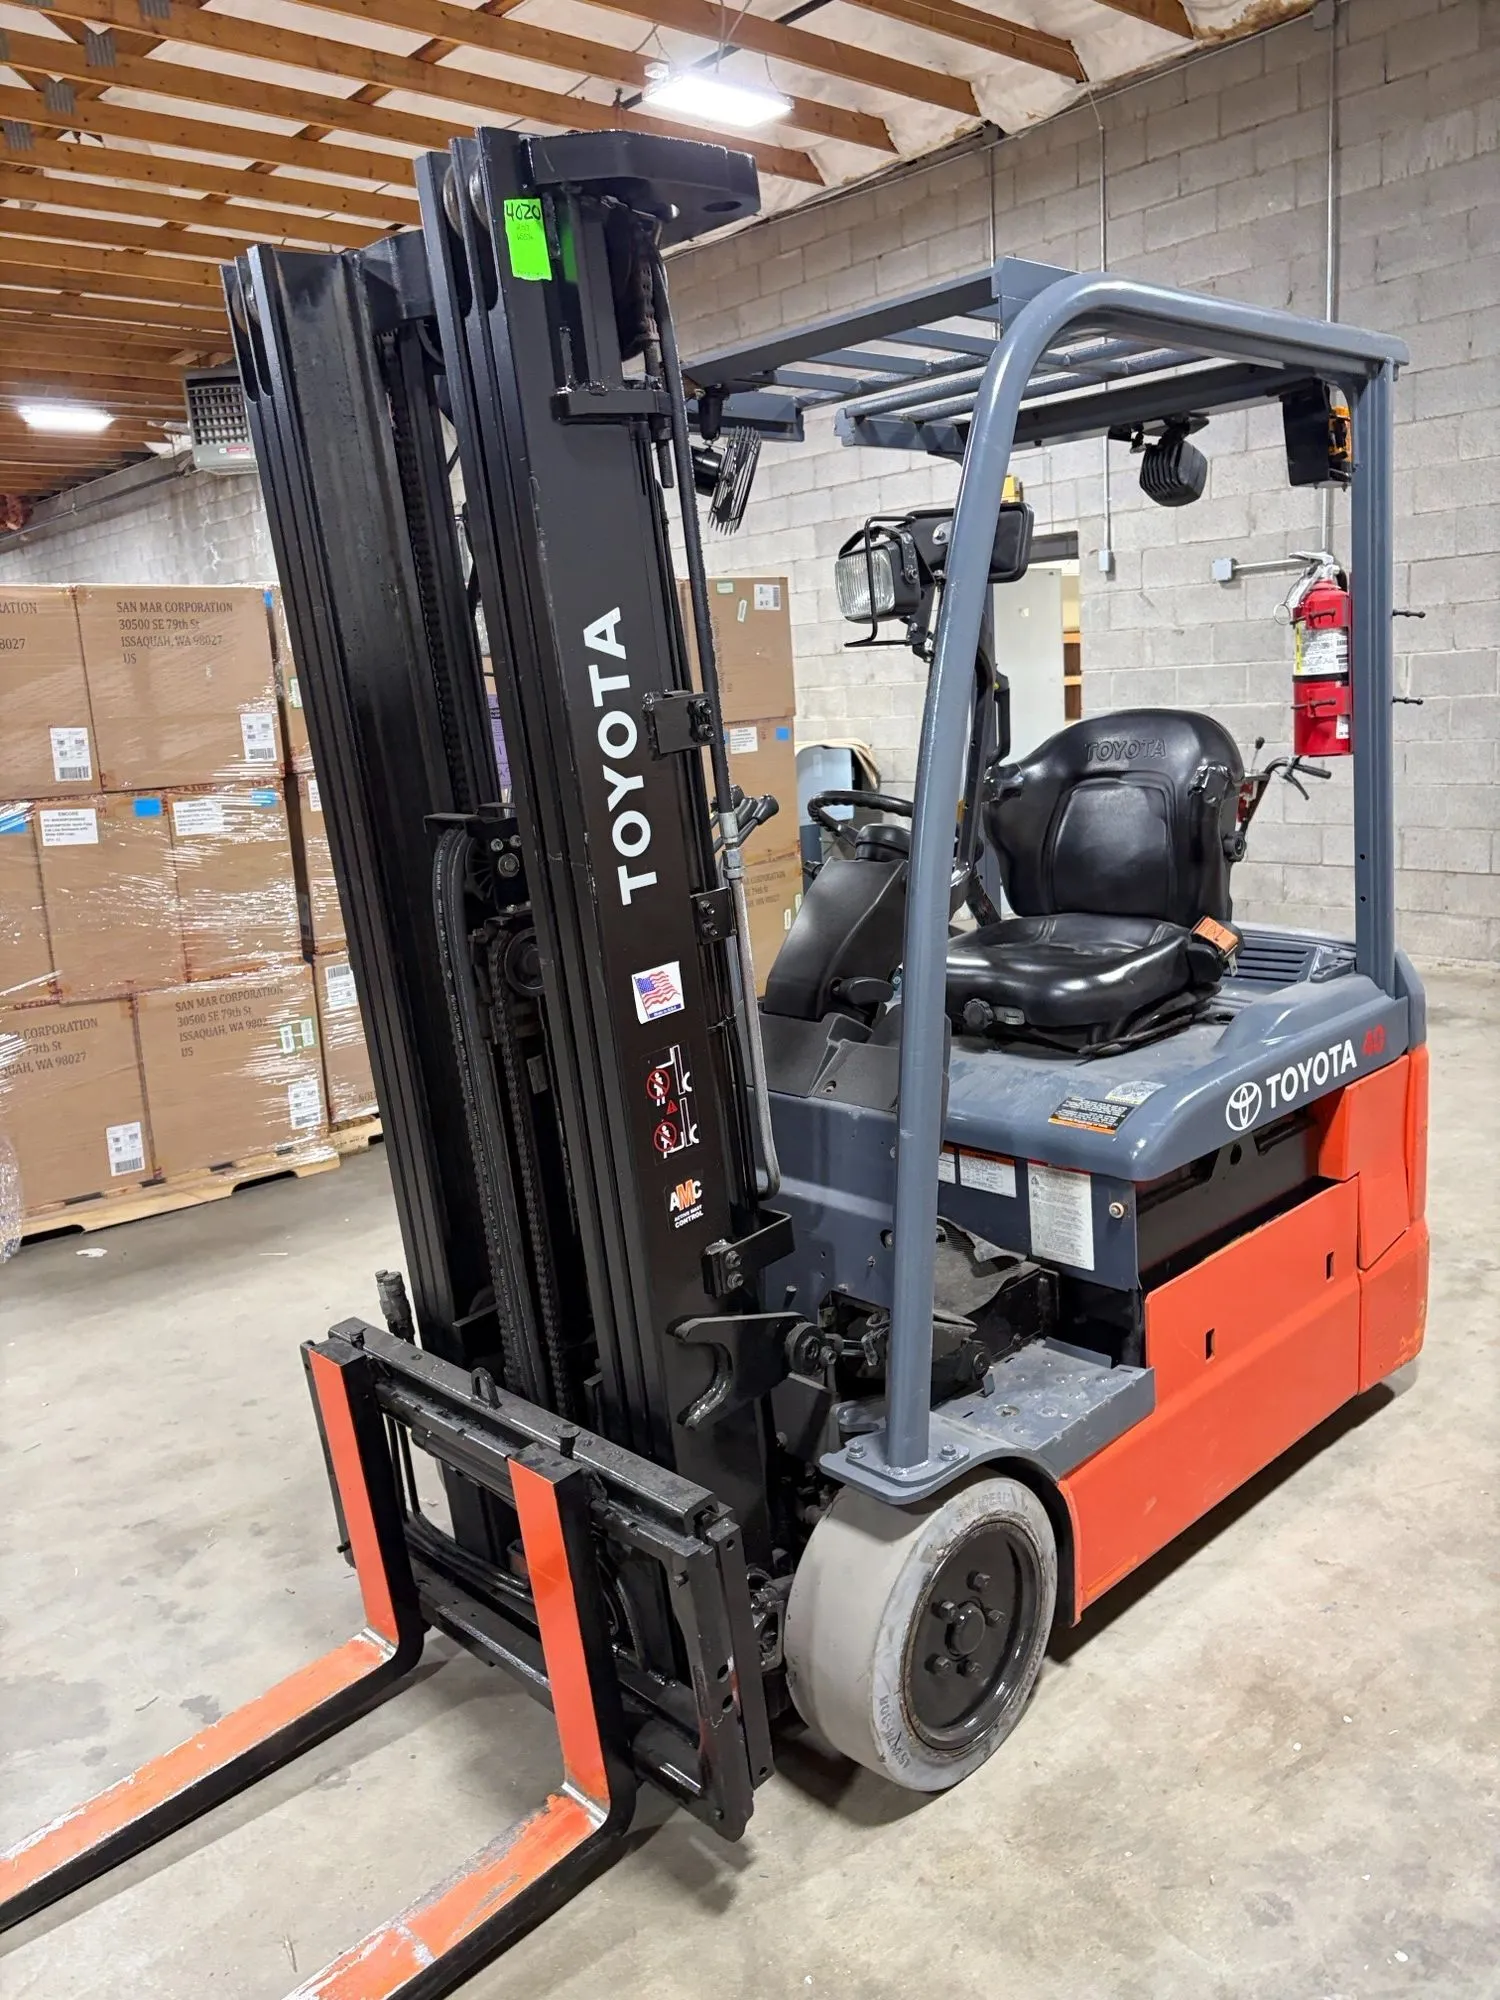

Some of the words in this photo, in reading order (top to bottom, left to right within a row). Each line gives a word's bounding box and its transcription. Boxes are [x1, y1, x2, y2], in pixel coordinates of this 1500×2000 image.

[506, 203, 541, 221] 4020
[116, 601, 138, 613] SAN
[140, 601, 162, 613] MAR
[164, 602, 233, 613] CORPORATION
[119, 619, 150, 630] 30500
[152, 619, 164, 630] SE
[166, 619, 189, 630] 79th
[0, 638, 26, 650] 8027
[175, 635, 191, 647] WA
[193, 635, 223, 646] 98027
[123, 653, 137, 665] US
[583, 606, 658, 906] TOYOTA
[1085, 739, 1168, 761] TOYOTA
[175, 1001, 194, 1012] SAN
[197, 995, 218, 1009] MAR
[219, 986, 284, 1005] CORPORATION
[208, 1010, 219, 1021] SE
[221, 1006, 242, 1020] 79th
[243, 1005, 252, 1015] St
[23, 1017, 99, 1040] CORPORATION
[180, 1024, 228, 1042] ISSAQUAH,
[229, 1021, 244, 1033] WA
[52, 1040, 62, 1051] St
[181, 1046, 194, 1058] US
[35, 1057, 54, 1071] WA
[55, 1051, 86, 1067] 98027
[1266, 1039, 1358, 1109] TOYOTA
[1362, 1024, 1386, 1056] 40
[670, 1179, 703, 1212] AMC
[674, 1210, 705, 1229] CONTROL
